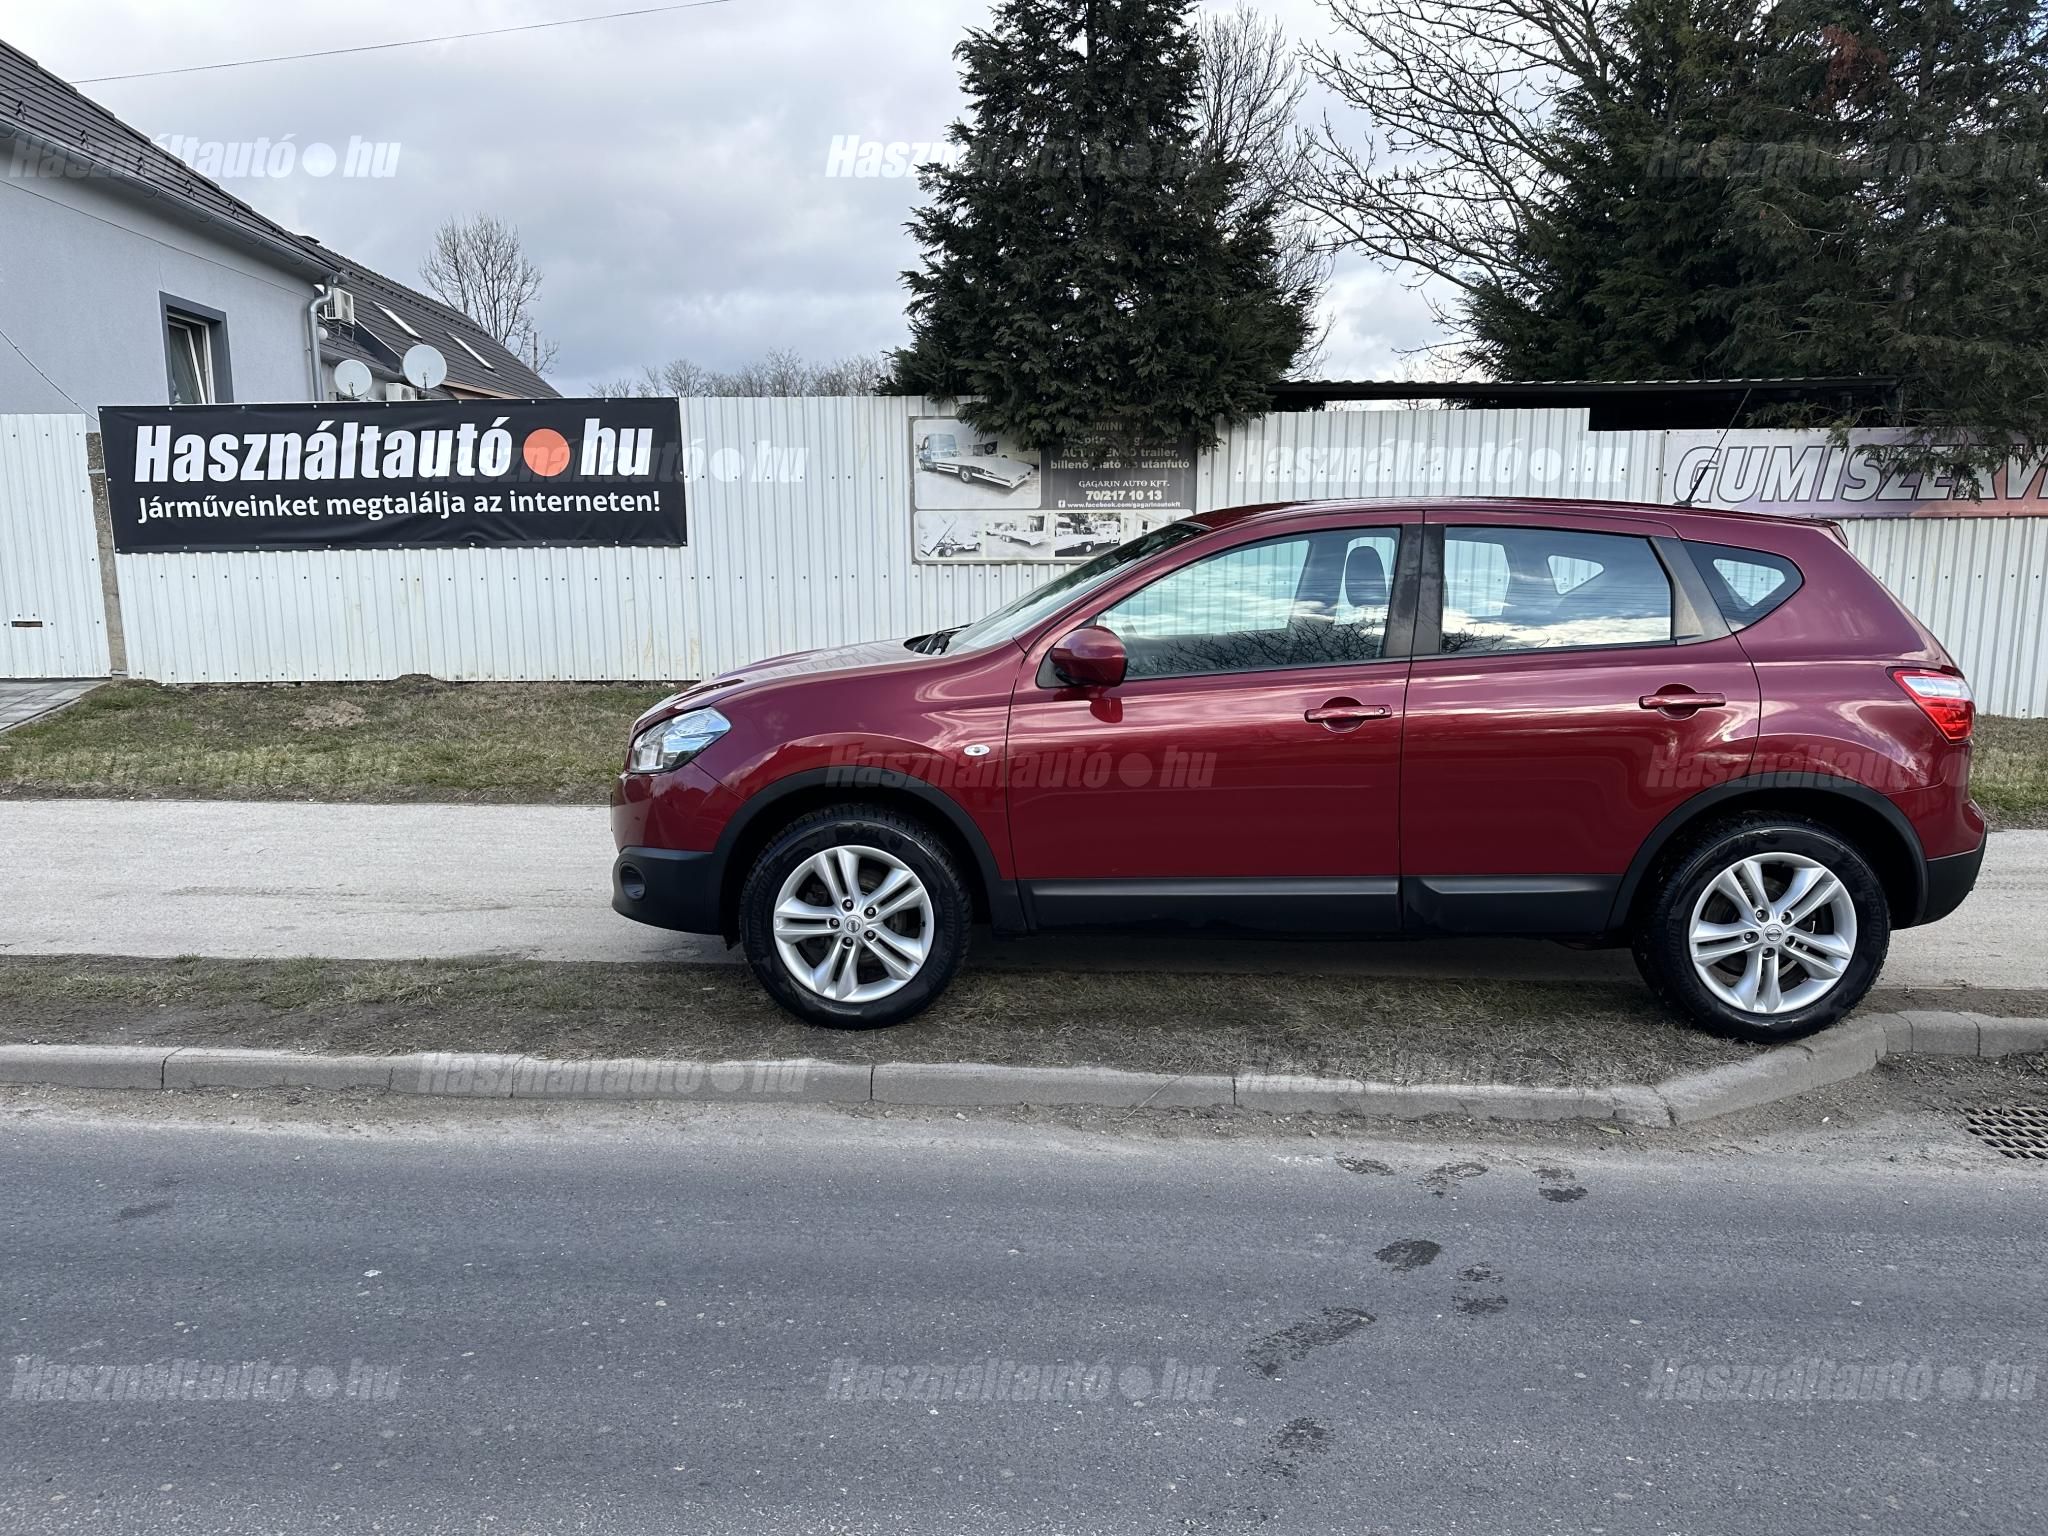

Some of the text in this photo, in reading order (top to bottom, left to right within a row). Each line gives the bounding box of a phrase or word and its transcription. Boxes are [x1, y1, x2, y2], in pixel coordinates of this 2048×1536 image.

[135, 417, 653, 482] Használtautó hu
[1050, 458, 1089, 469] billenő
[1141, 458, 1190, 469] utánfutó
[1674, 445, 2048, 504] GUMISZERV
[1078, 480, 1120, 488] GAGARIN
[1123, 480, 1148, 488] AUTO
[138, 490, 660, 523] Járműveinket megtalálja az interneten!
[1085, 490, 1162, 501] 70/217 10 13
